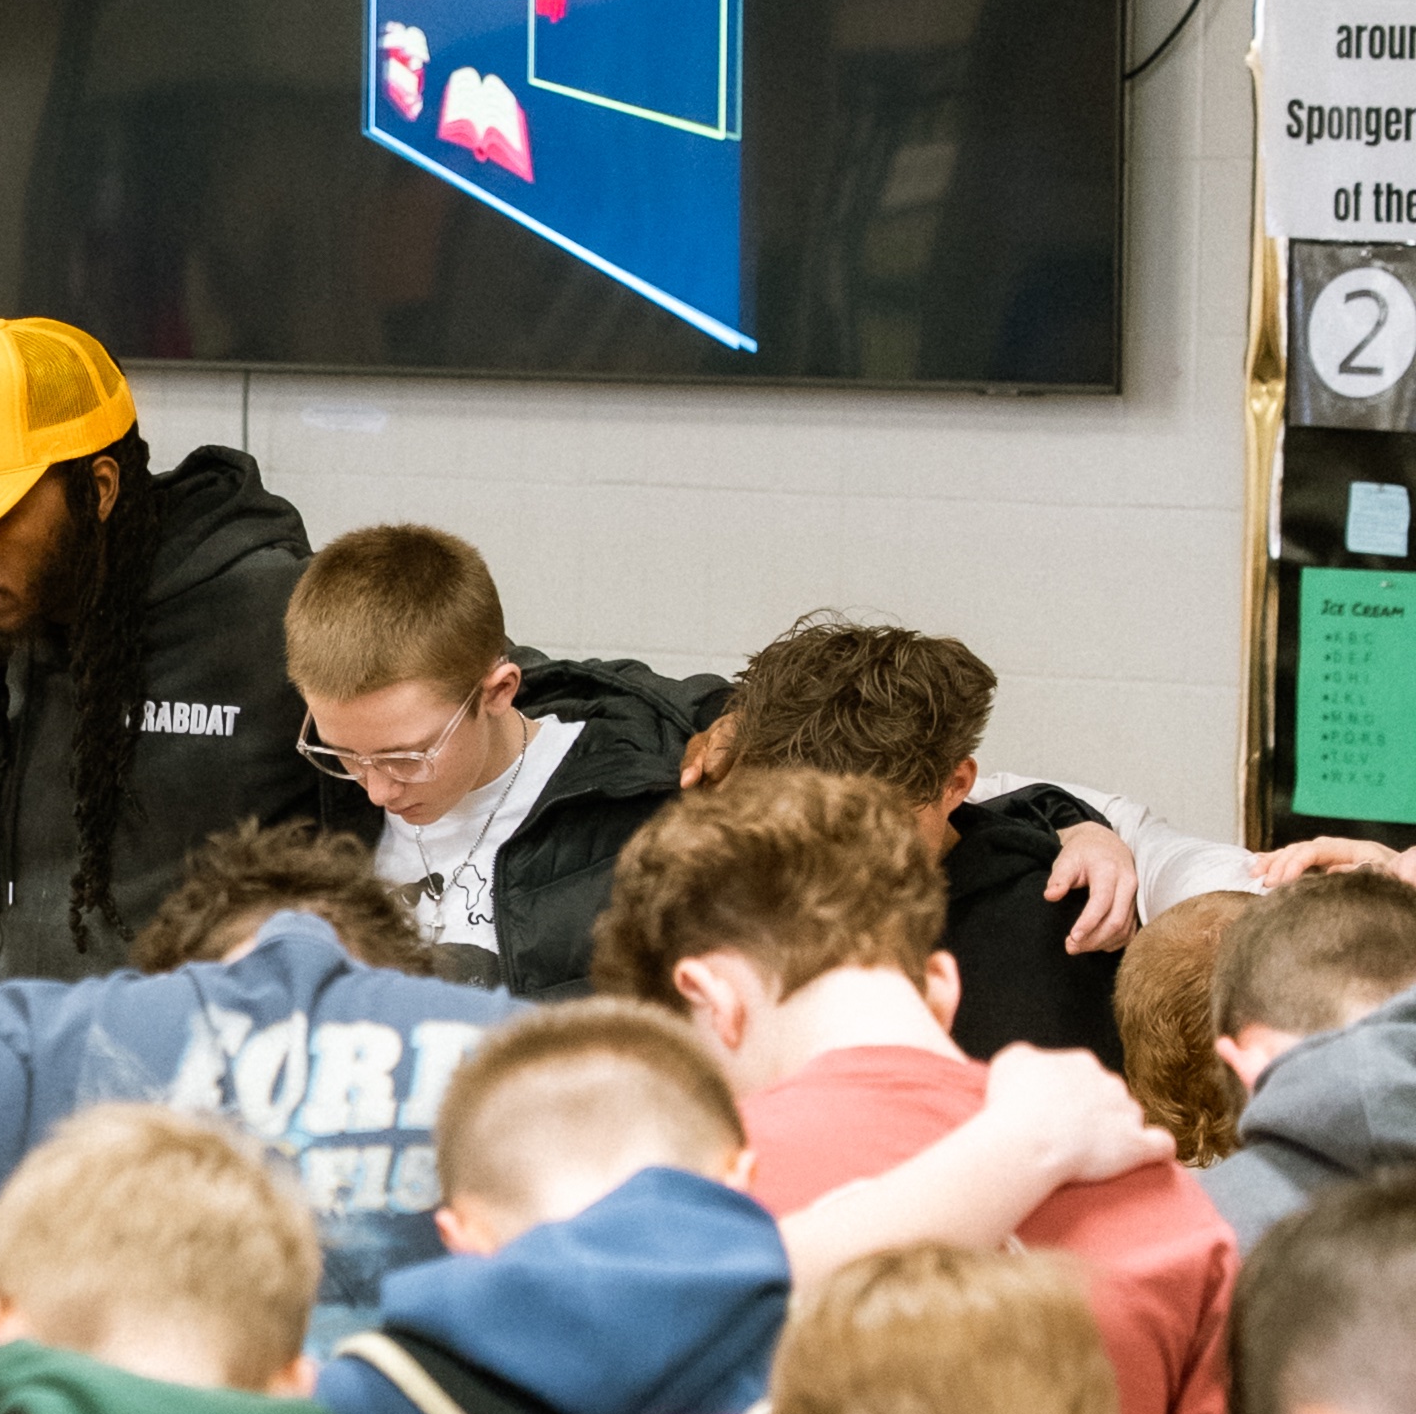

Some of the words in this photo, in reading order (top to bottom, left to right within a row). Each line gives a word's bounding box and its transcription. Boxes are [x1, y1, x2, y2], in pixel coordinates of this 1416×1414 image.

[1333, 181, 1362, 223] of
[1338, 288, 1389, 376] 2
[1351, 601, 1406, 619] CREAM
[125, 700, 241, 736] RABDAT
